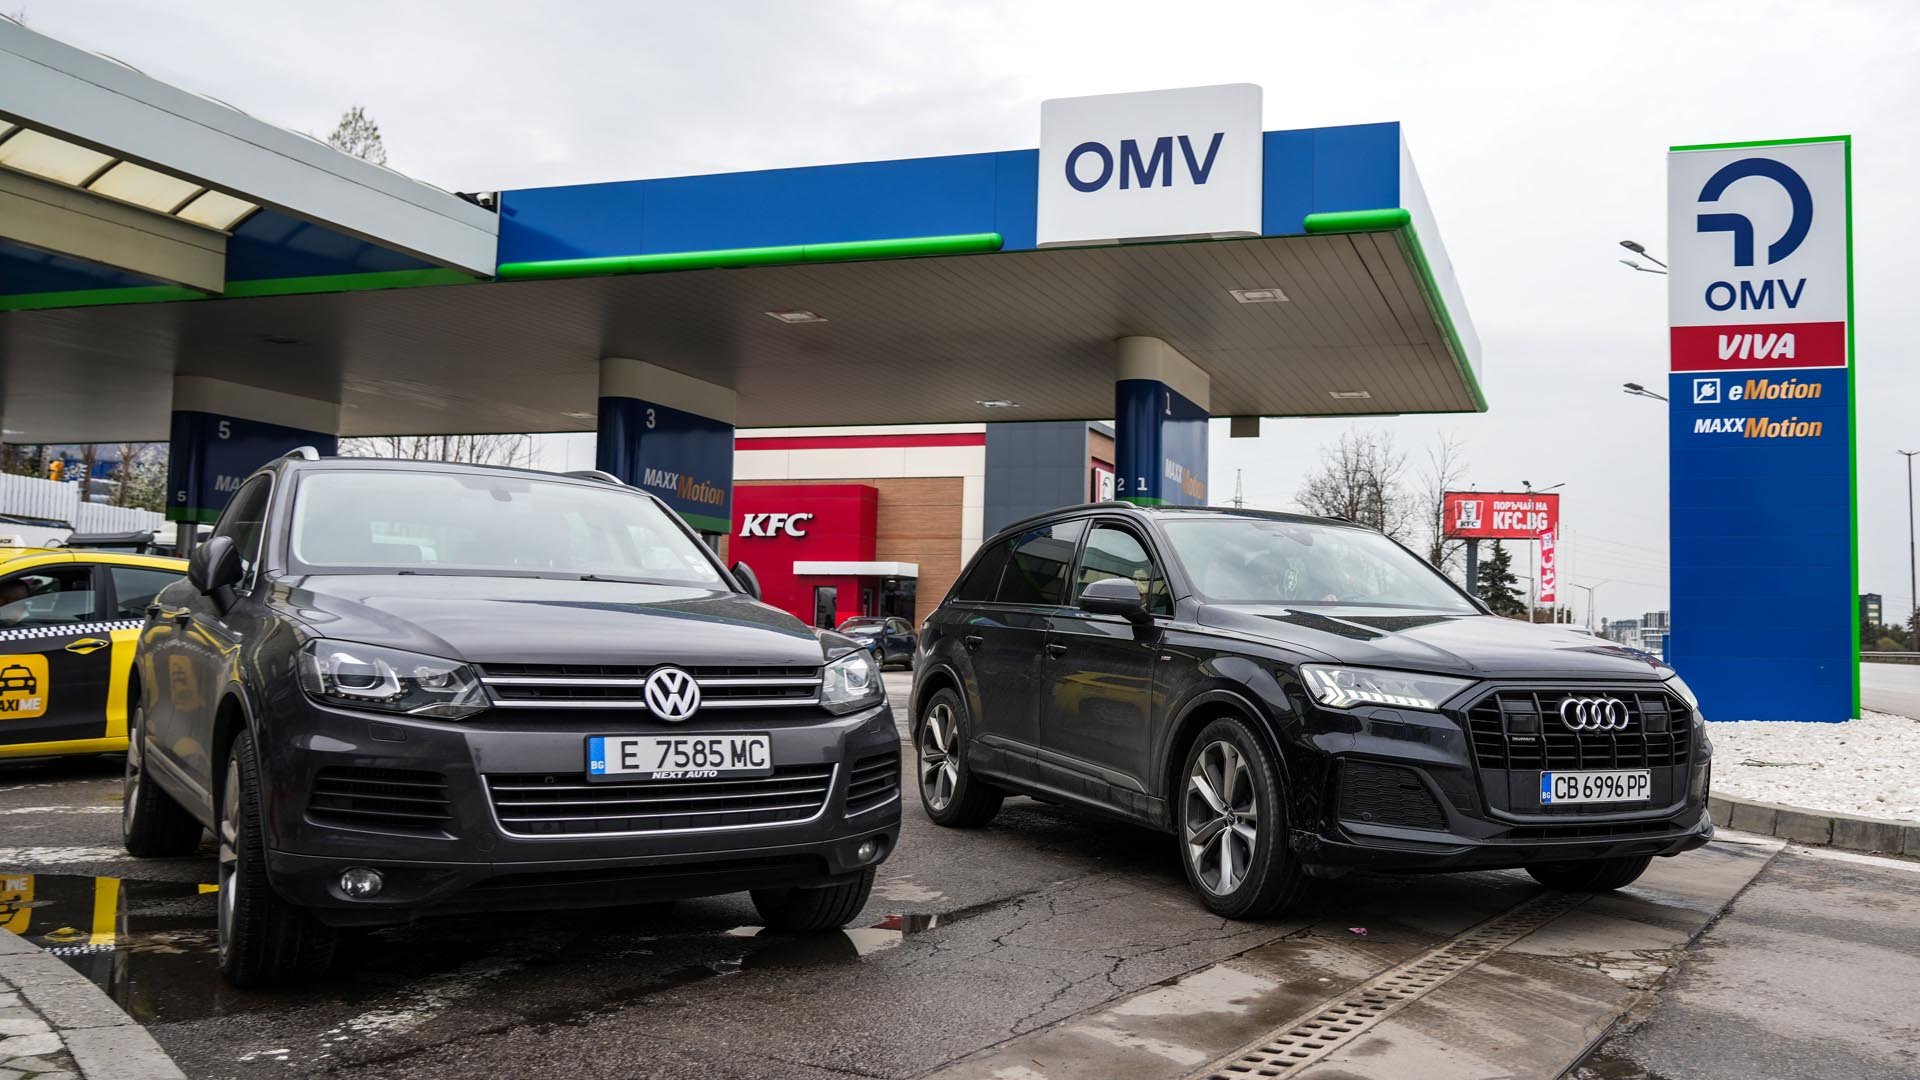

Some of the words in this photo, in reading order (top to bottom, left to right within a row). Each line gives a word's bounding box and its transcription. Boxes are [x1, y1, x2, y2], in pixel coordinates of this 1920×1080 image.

[1065, 132, 1225, 193] OMV
[1705, 278, 1807, 312] OMV
[1718, 333, 1796, 361] VIVA
[1728, 378, 1823, 401] eMotion
[1165, 392, 1172, 415] 1
[645, 408, 656, 429] 3
[218, 420, 231, 440] 5
[1117, 478, 1125, 491] 2
[1137, 477, 1148, 491] 1
[177, 491, 187, 502] 5
[1536, 501, 1548, 510] НА
[739, 513, 812, 537] KFC
[1460, 520, 1478, 528] KFC
[1493, 511, 1549, 531] KFC.BG
[620, 740, 640, 770] E
[656, 739, 724, 769] 7585
[730, 739, 765, 768] MC
[591, 760, 605, 770] BG
[652, 771, 682, 780] NEXT
[686, 770, 718, 779] AUTO
[1542, 791, 1551, 799] BG
[1555, 776, 1579, 799] CB
[1583, 776, 1624, 799] 6996
[1627, 774, 1648, 797] PP
